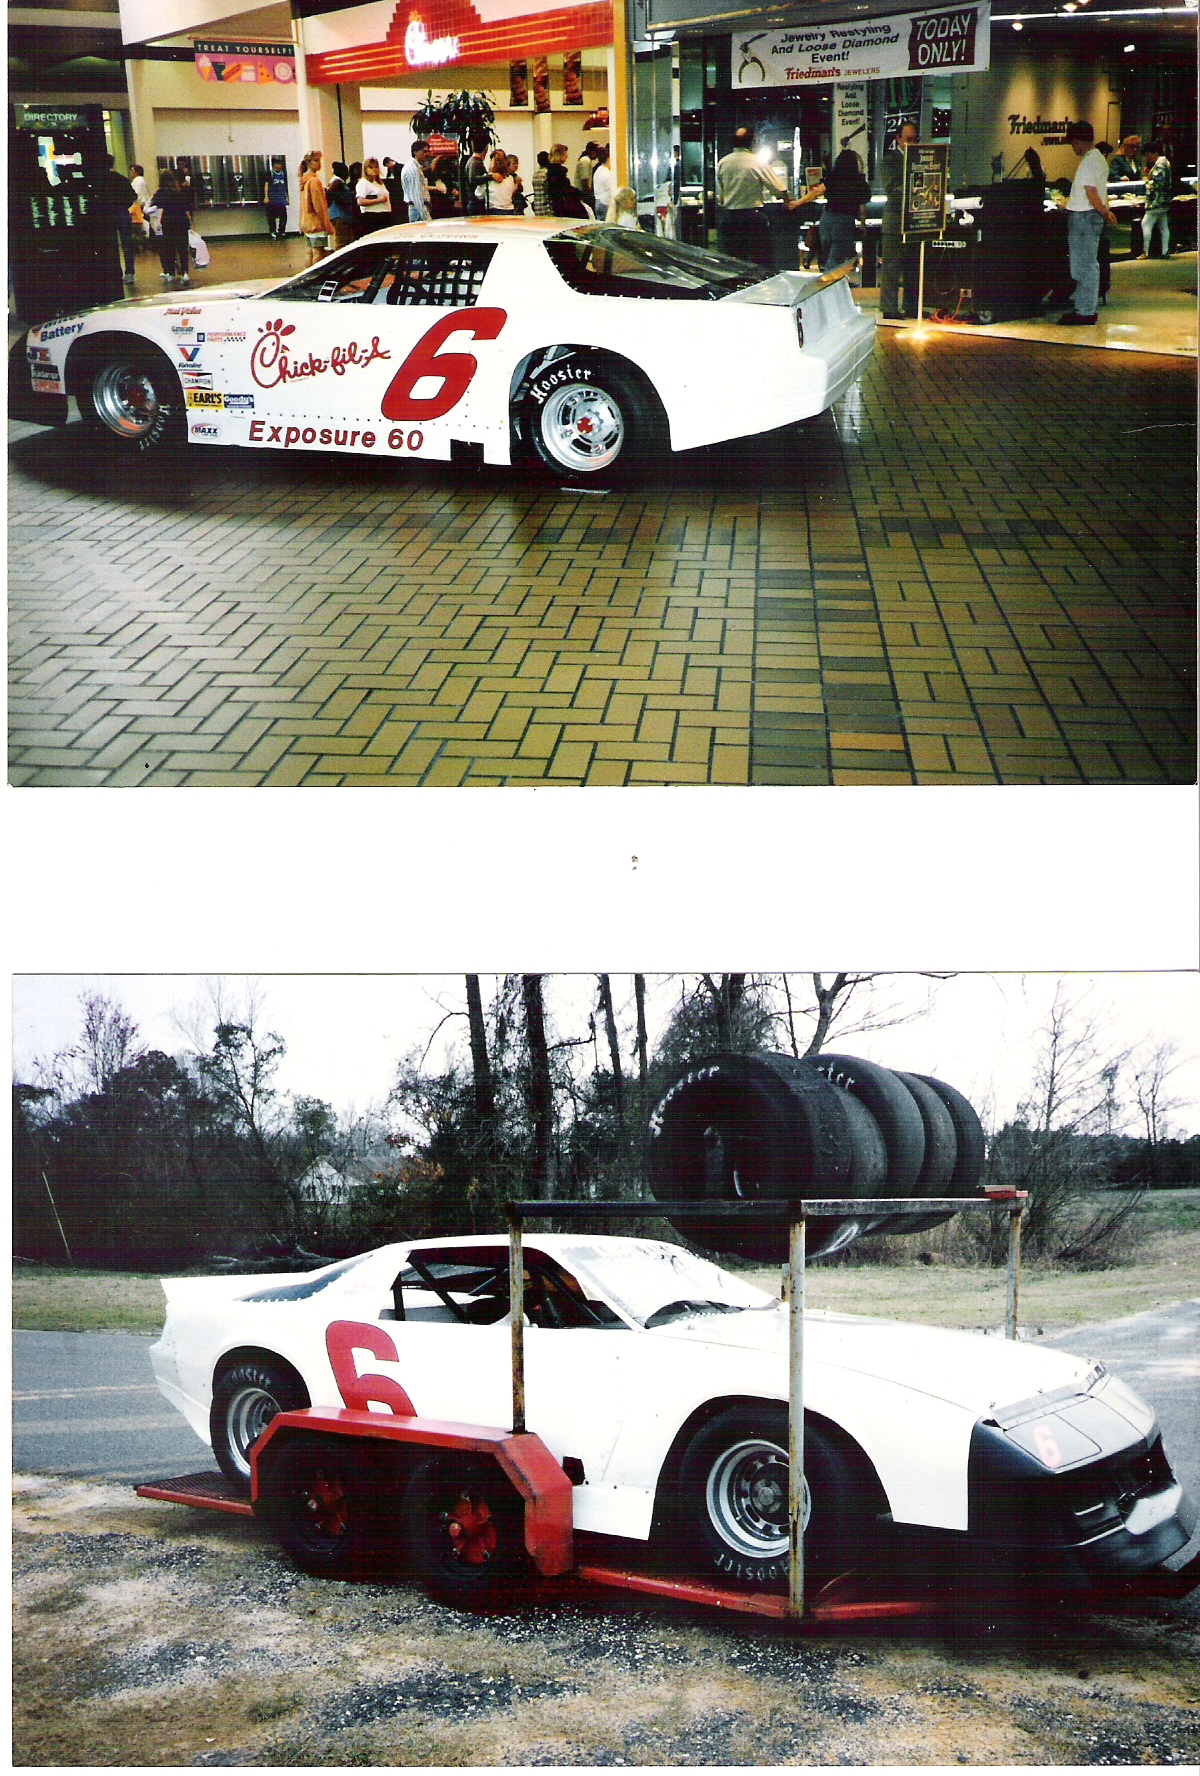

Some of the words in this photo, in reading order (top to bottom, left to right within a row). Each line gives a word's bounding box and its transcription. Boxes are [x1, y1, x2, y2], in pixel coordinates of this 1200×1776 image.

[781, 32, 826, 43] Jewelry
[830, 24, 891, 38] Restyling
[917, 13, 971, 41] TODAY
[198, 44, 228, 53] TREAT
[236, 46, 293, 55] YOURSELF!
[771, 44, 793, 55] And
[798, 41, 837, 52] Loose
[842, 33, 899, 49] Diamond
[917, 39, 968, 66] ONLY!
[811, 52, 849, 64] Event!
[784, 67, 841, 79] Friedman's
[844, 67, 880, 77] JEWELERS
[24, 113, 78, 122] DIRECTORY
[41, 322, 84, 342] Battery
[171, 325, 194, 333] Gatorade
[250, 319, 391, 389] Chick-fil-A
[381, 307, 508, 421] 6
[184, 377, 211, 385] CHAMPION
[529, 363, 593, 405] Hoosier
[193, 392, 222, 404] EARL'S
[249, 420, 376, 448] Exposure
[388, 428, 424, 451] 60
[325, 1320, 418, 1417] 6
[1033, 1424, 1061, 1470] 6
